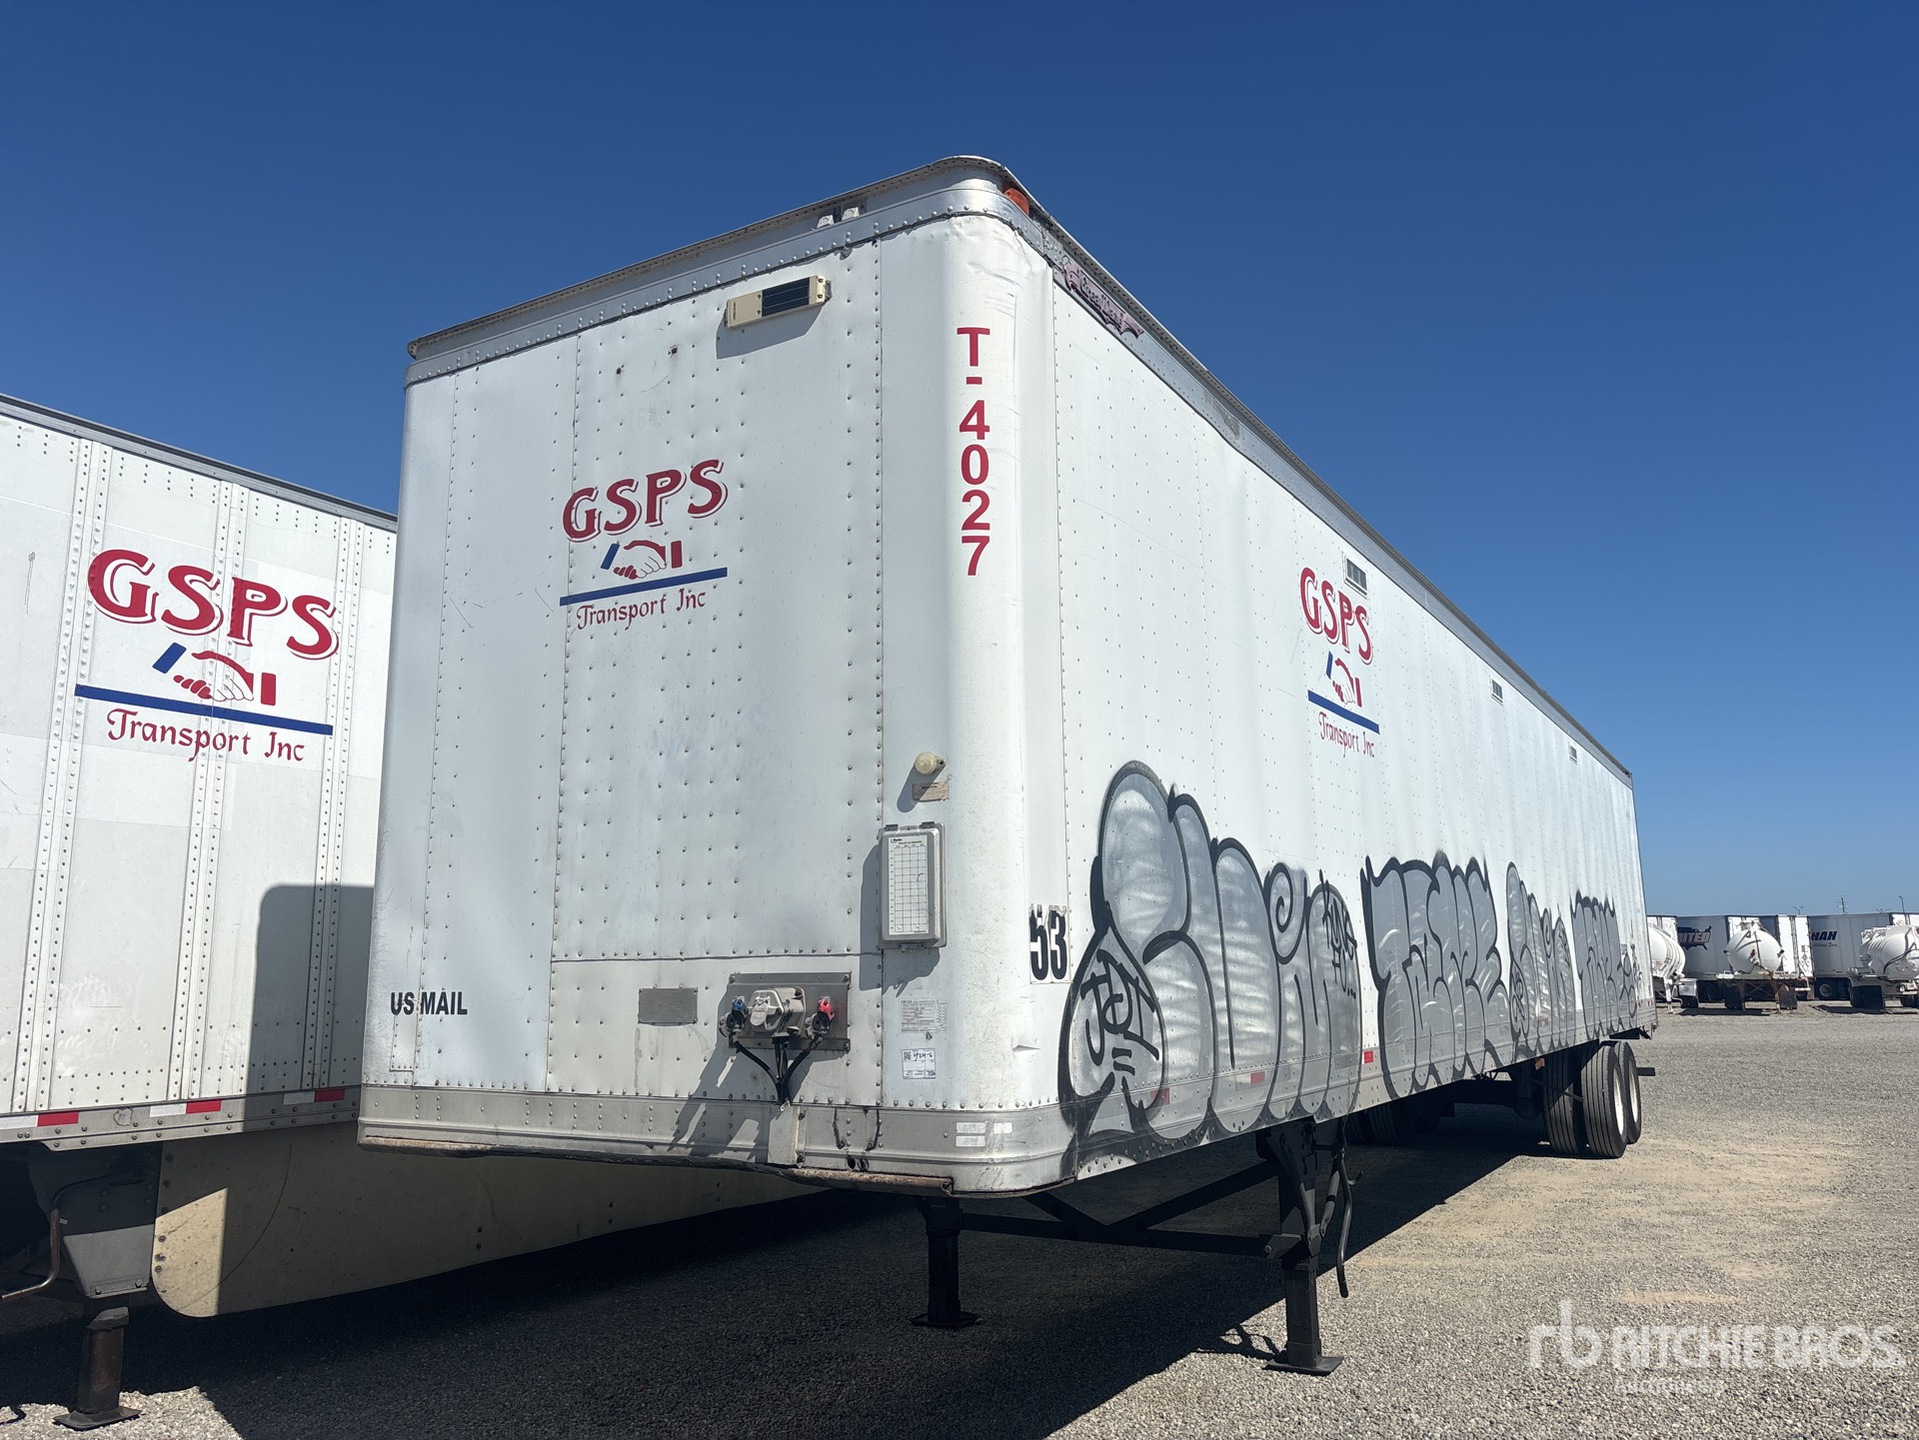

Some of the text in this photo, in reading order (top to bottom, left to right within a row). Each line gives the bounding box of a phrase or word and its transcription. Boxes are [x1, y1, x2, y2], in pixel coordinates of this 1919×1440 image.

[957, 327, 991, 576] T-4027
[562, 459, 729, 544] GSPS
[87, 549, 339, 661] GSPS
[576, 588, 706, 631] Transport Inc
[1300, 567, 1374, 666] GSPS
[107, 708, 305, 762] Transport Inc
[1318, 711, 1375, 759] Transport Inc
[1029, 903, 1068, 981] 53
[390, 991, 468, 1016] US MAIL
